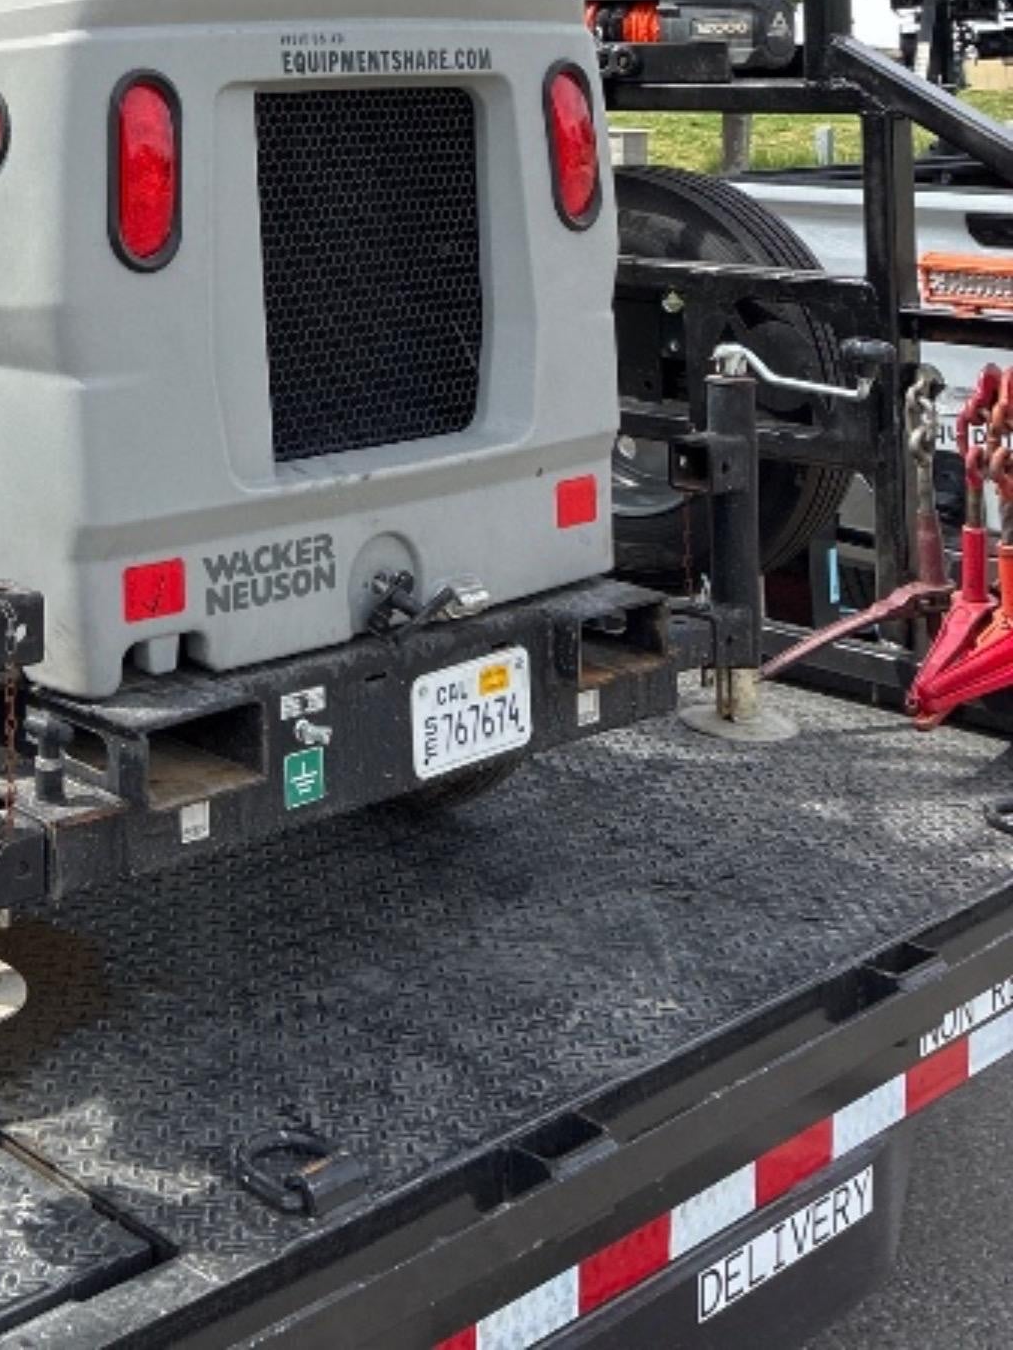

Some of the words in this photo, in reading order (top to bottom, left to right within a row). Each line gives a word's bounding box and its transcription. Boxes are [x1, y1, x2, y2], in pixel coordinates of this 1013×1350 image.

[281, 48, 492, 75] EQUIPMENTSHARE.COM
[202, 533, 336, 584] WACKER
[205, 561, 336, 616] NEUSON
[437, 680, 468, 706] CAL
[441, 693, 519, 754] 767674
[701, 1168, 871, 1318] DELIVERY
